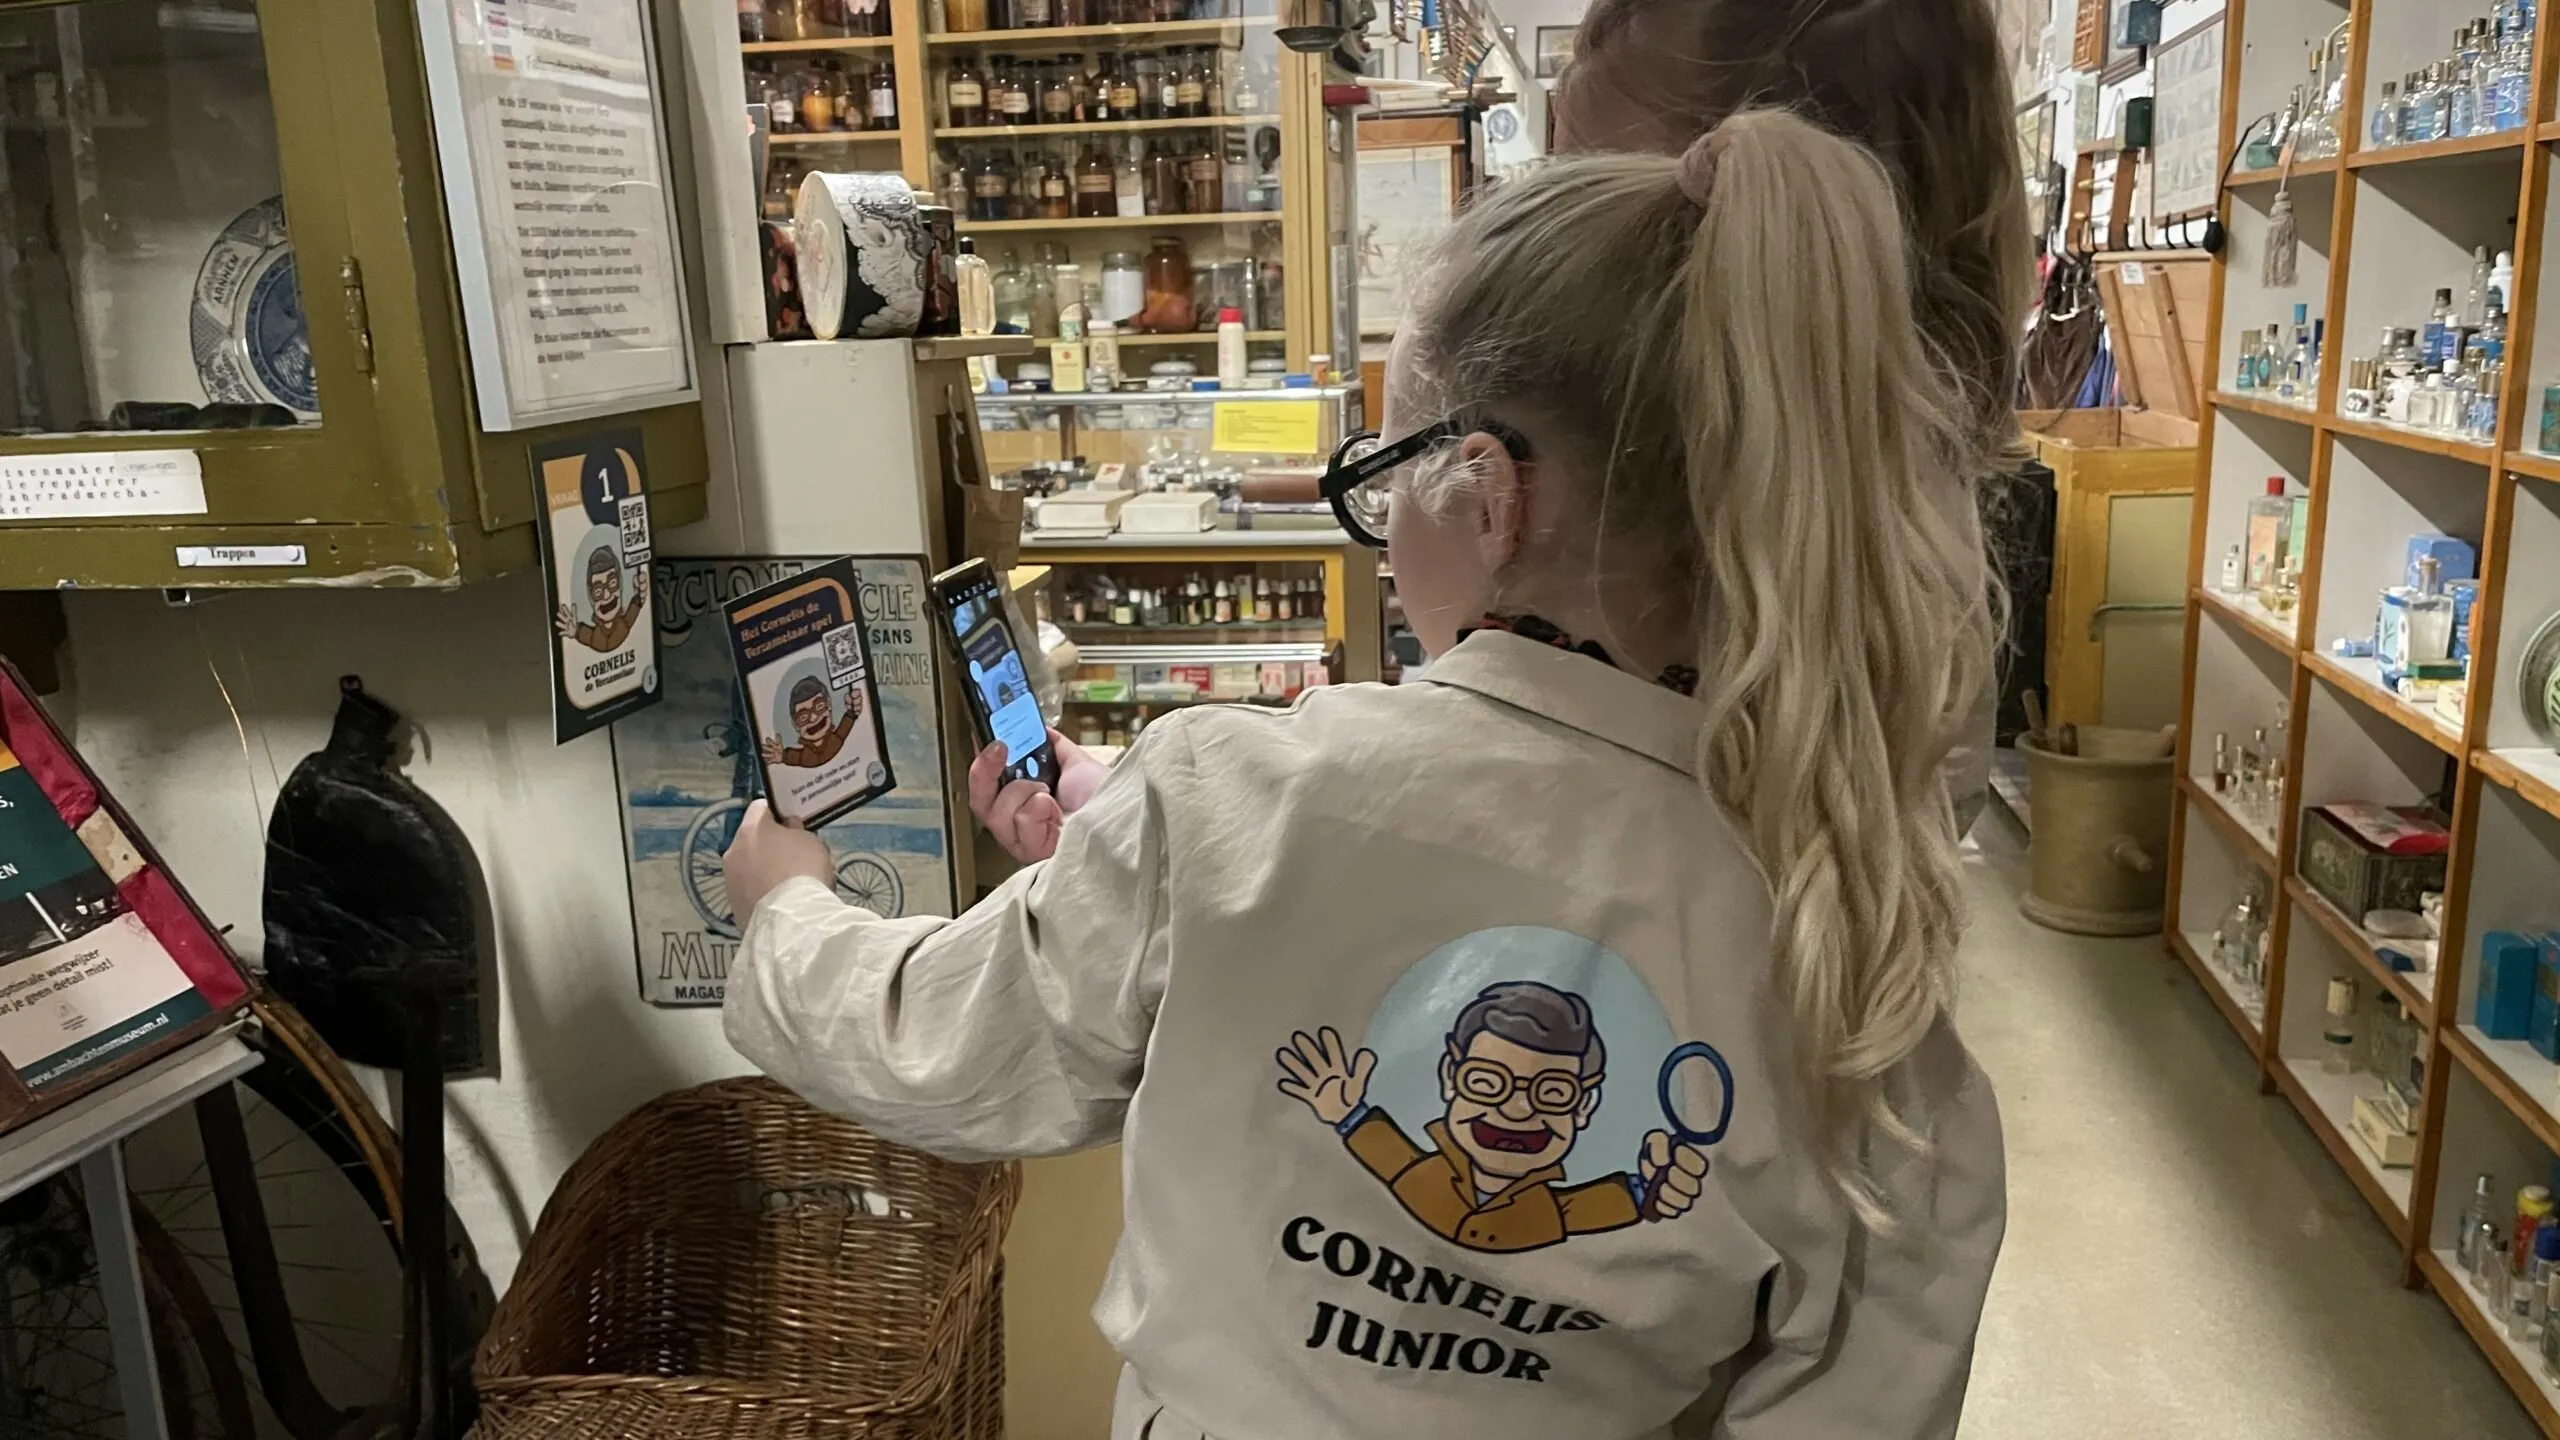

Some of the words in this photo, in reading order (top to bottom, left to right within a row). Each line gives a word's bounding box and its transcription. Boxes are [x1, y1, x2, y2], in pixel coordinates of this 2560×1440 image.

[599, 467, 614, 503] 1
[871, 629, 912, 645] SANS
[584, 649, 636, 681] CORNELIS
[1281, 1216, 1611, 1335] CORNELIS
[1306, 1301, 1551, 1382] JUNIOR
